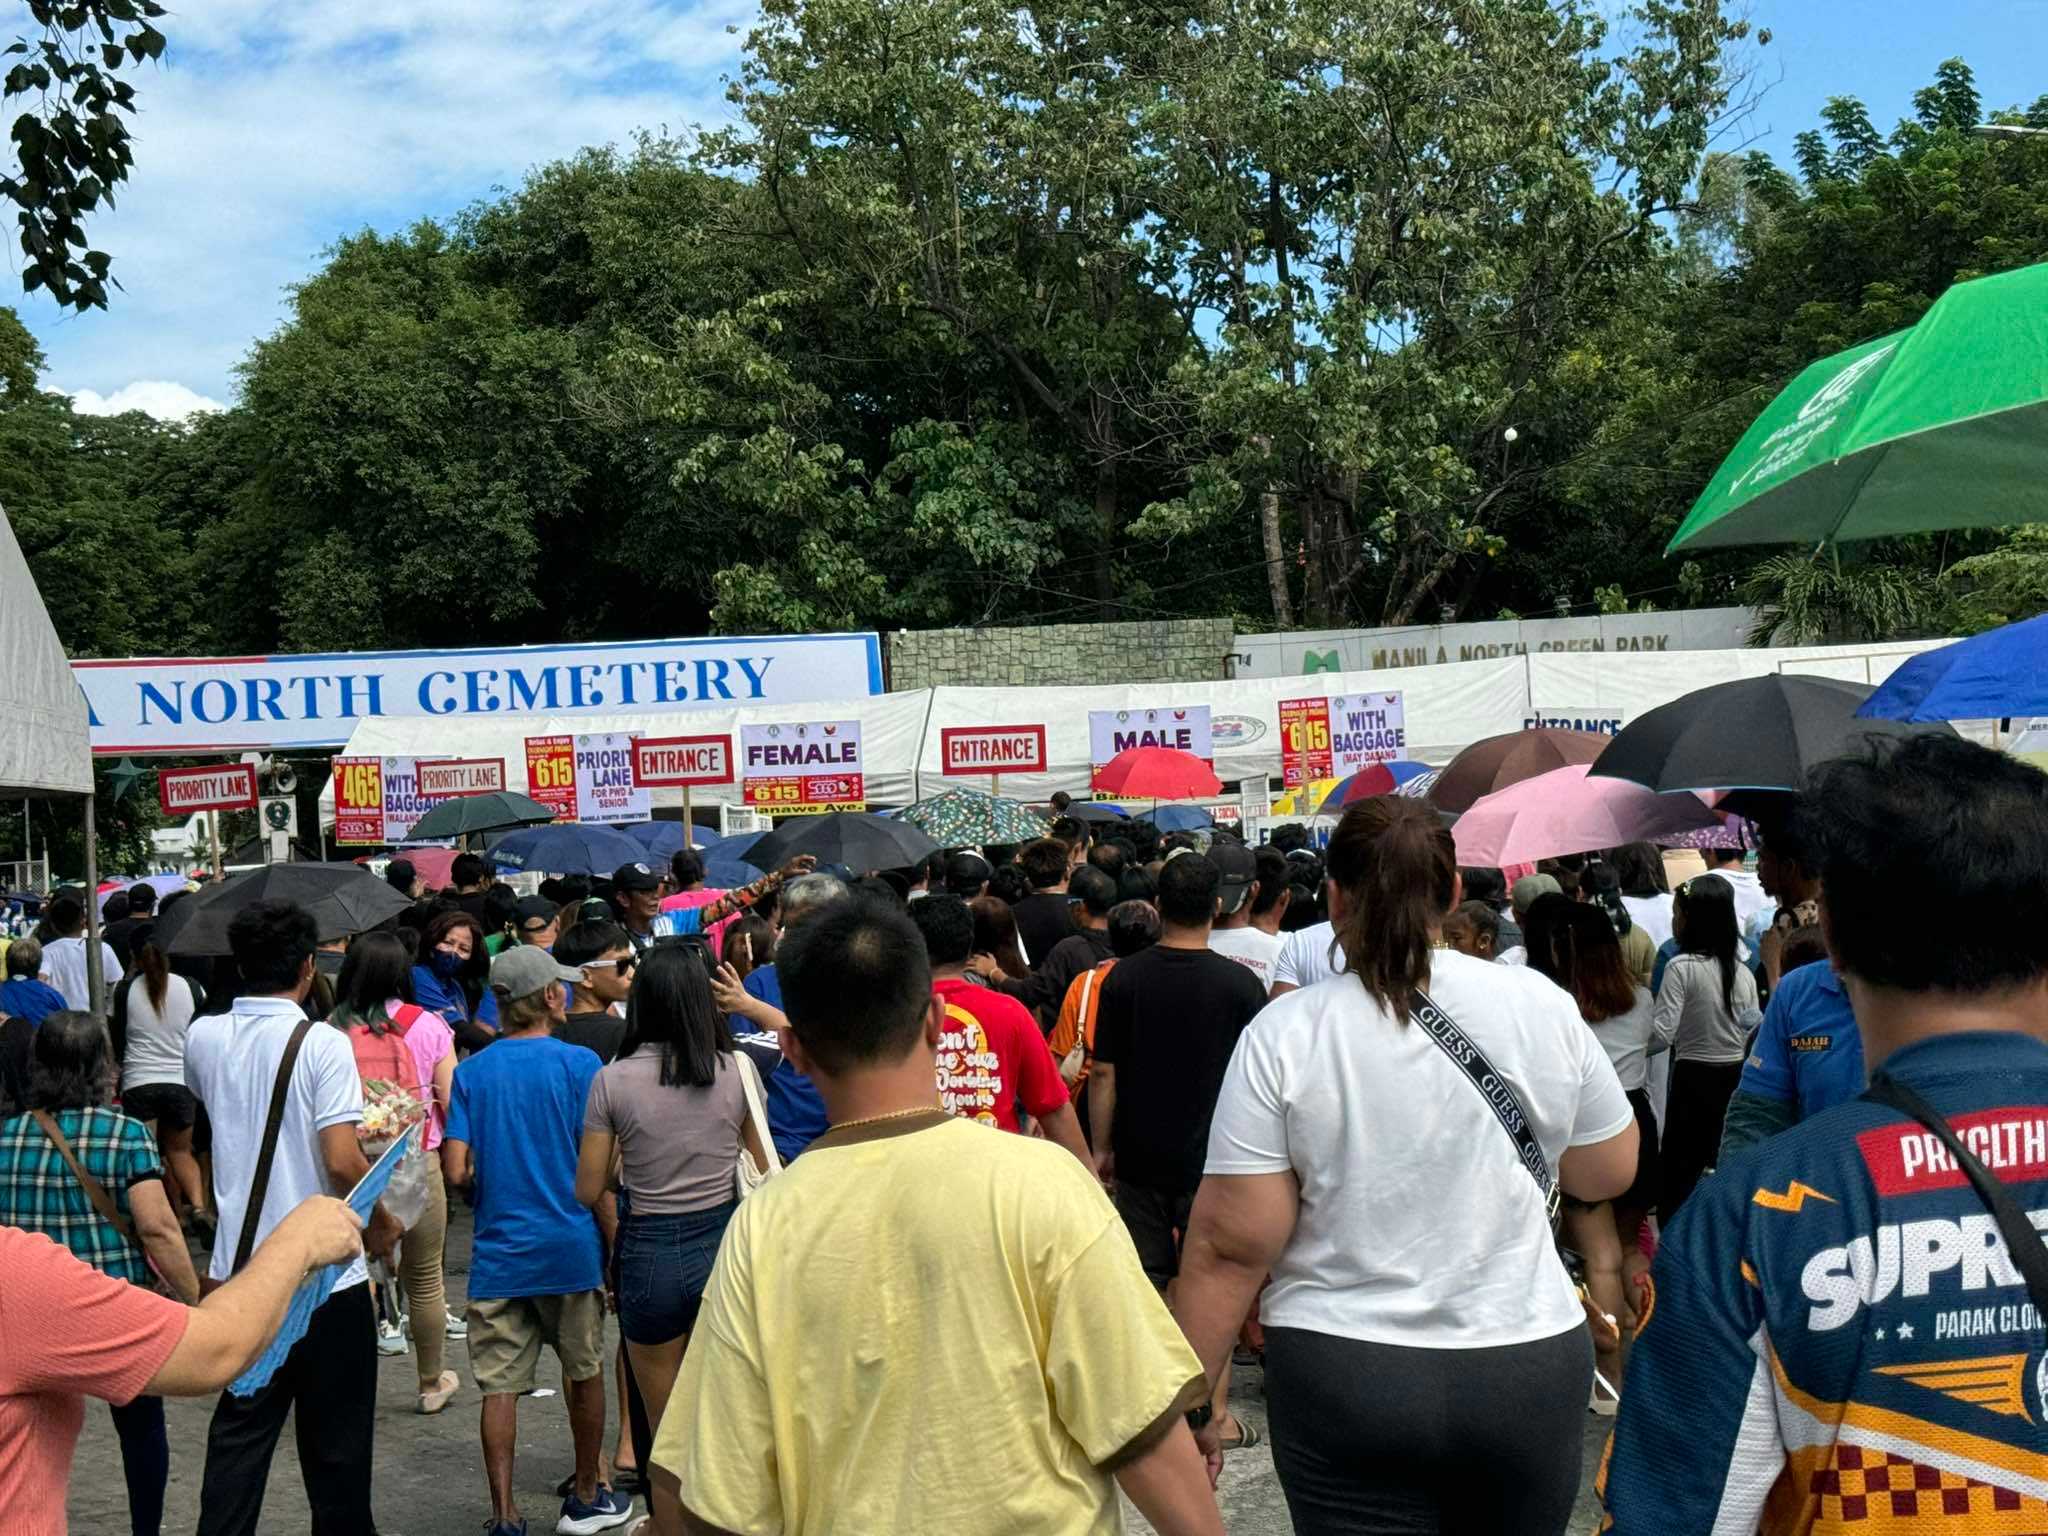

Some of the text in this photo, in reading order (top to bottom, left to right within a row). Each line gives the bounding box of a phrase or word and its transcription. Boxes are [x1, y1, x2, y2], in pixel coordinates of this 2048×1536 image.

[136, 673, 386, 725] NORTH
[418, 656, 775, 715] CEMETERY
[1346, 709, 1387, 731] WITH
[1114, 728, 1192, 753] MALE
[1289, 720, 1329, 752] 615
[1333, 728, 1405, 753] BAGGAGE
[576, 749, 632, 770] PRIORIT
[641, 748, 719, 775] ENTRANCE
[747, 742, 857, 766] FEMALE
[951, 738, 1034, 763] ENTRANCE
[423, 767, 497, 790] PRIORITY LANE
[536, 757, 573, 788] 615
[592, 768, 631, 788] LANE
[169, 775, 249, 802] PRIORITY LANE
[343, 764, 382, 808] 465
[592, 787, 634, 799] FOR PWD &
[754, 785, 800, 801] 615
[599, 798, 629, 809] SENIOR
[755, 805, 818, 815] anawe
[1419, 1006, 1476, 1065] GUESS
[1481, 1073, 1525, 1134] GUESS
[1935, 1307, 1997, 1340] PARAK
